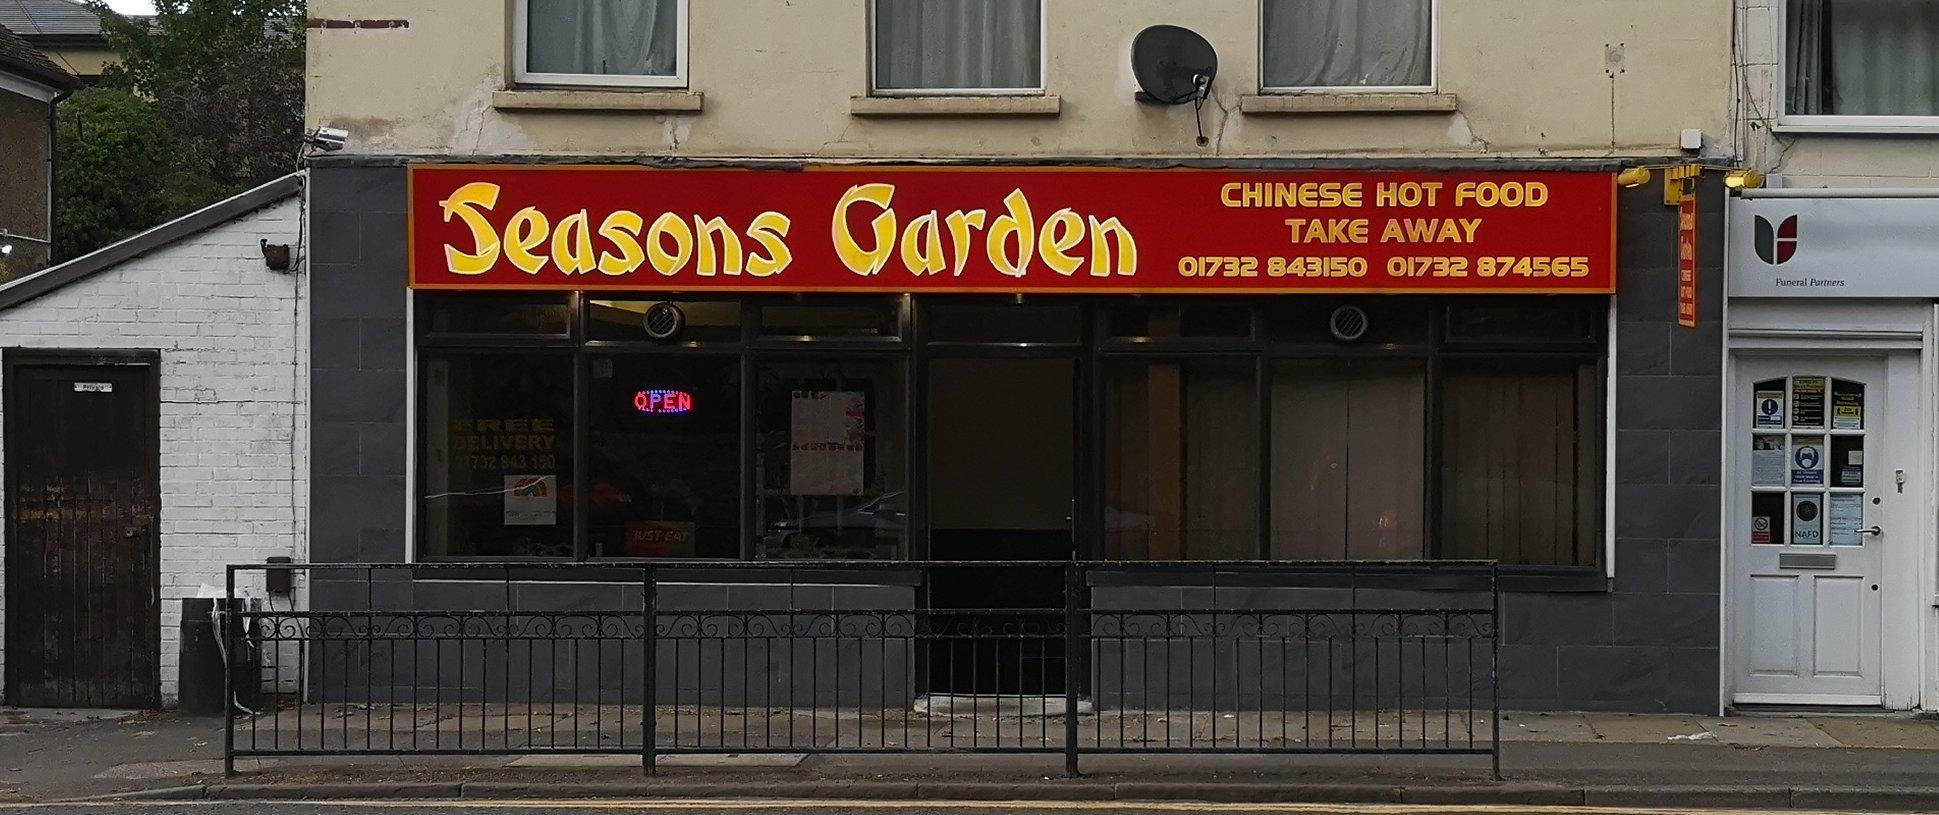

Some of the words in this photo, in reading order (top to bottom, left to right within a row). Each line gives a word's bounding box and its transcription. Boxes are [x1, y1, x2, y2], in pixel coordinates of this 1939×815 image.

[1221, 182, 1362, 207] CHINESE
[1376, 182, 1442, 207] HOT
[1455, 182, 1548, 207] FOOD
[440, 182, 793, 277] Seasons
[832, 183, 1137, 278] Garden
[1285, 219, 1368, 243] TAKE
[1380, 219, 1482, 243] AWAY
[1178, 256, 1258, 277] 01732
[1267, 256, 1368, 277] 843150
[1387, 256, 1468, 277] 01732
[1477, 256, 1589, 277] 874565
[1775, 278, 1807, 287] Funeral
[1809, 278, 1845, 287] Partners
[634, 392, 691, 411] OPEN
[453, 433, 555, 451] DELIVERY
[632, 529, 663, 541] JUST
[664, 530, 690, 542] EAT
